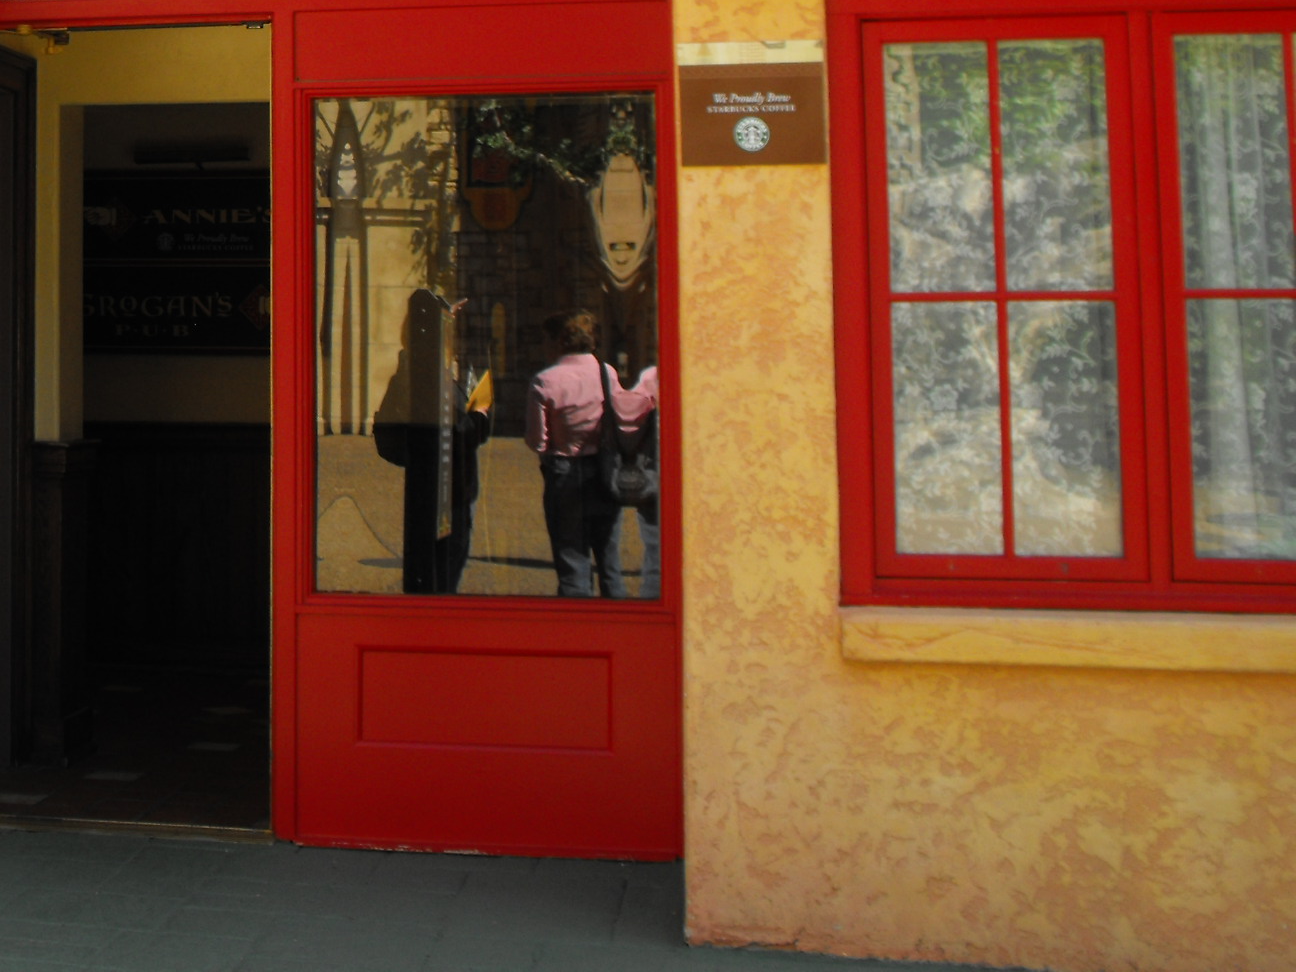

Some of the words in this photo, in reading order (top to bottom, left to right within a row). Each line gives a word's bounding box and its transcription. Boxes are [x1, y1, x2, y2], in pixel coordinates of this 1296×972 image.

[713, 92, 728, 104] We
[729, 91, 765, 106] Proudly
[767, 91, 791, 103] Brew
[706, 105, 760, 114] STARBUCKS
[761, 104, 797, 113] COFFEE
